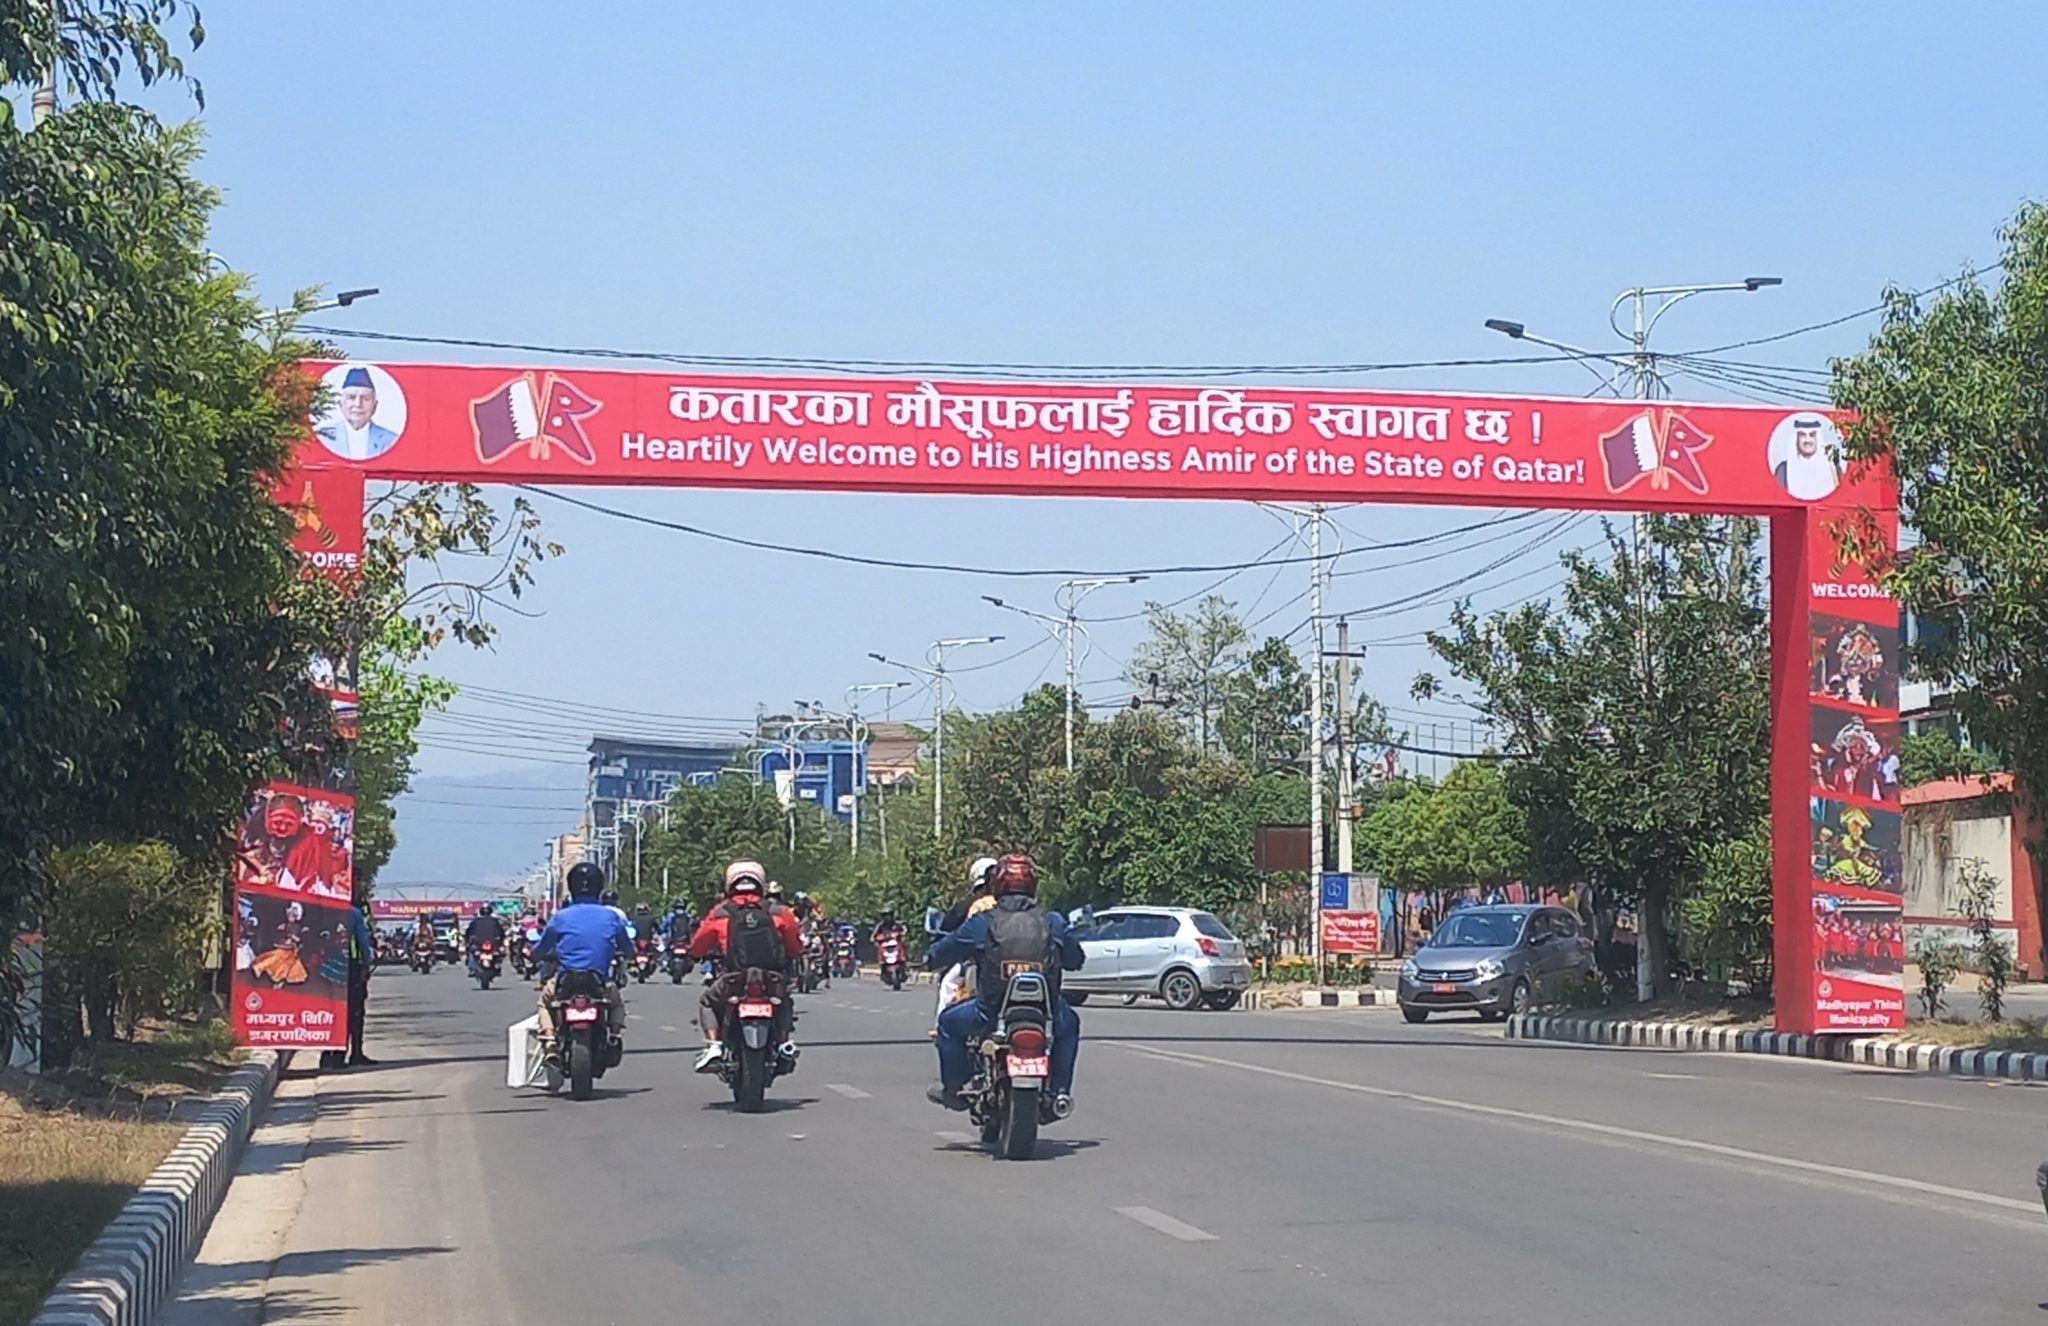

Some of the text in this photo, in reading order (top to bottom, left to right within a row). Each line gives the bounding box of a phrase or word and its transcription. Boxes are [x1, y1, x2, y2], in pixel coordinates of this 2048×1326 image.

[670, 387, 872, 425] कतारका
[887, 382, 1134, 438] मौसूफलाई
[1148, 390, 1294, 436] हार्दिक
[1308, 402, 1450, 441] स्वागत
[1465, 409, 1511, 444] छ
[622, 433, 1584, 482] Heartily Welcome to His Highness Amir of the State of Qatar!
[1816, 999, 1902, 1013] Madhyapur Thimi
[1829, 1014, 1890, 1026] Municipality
